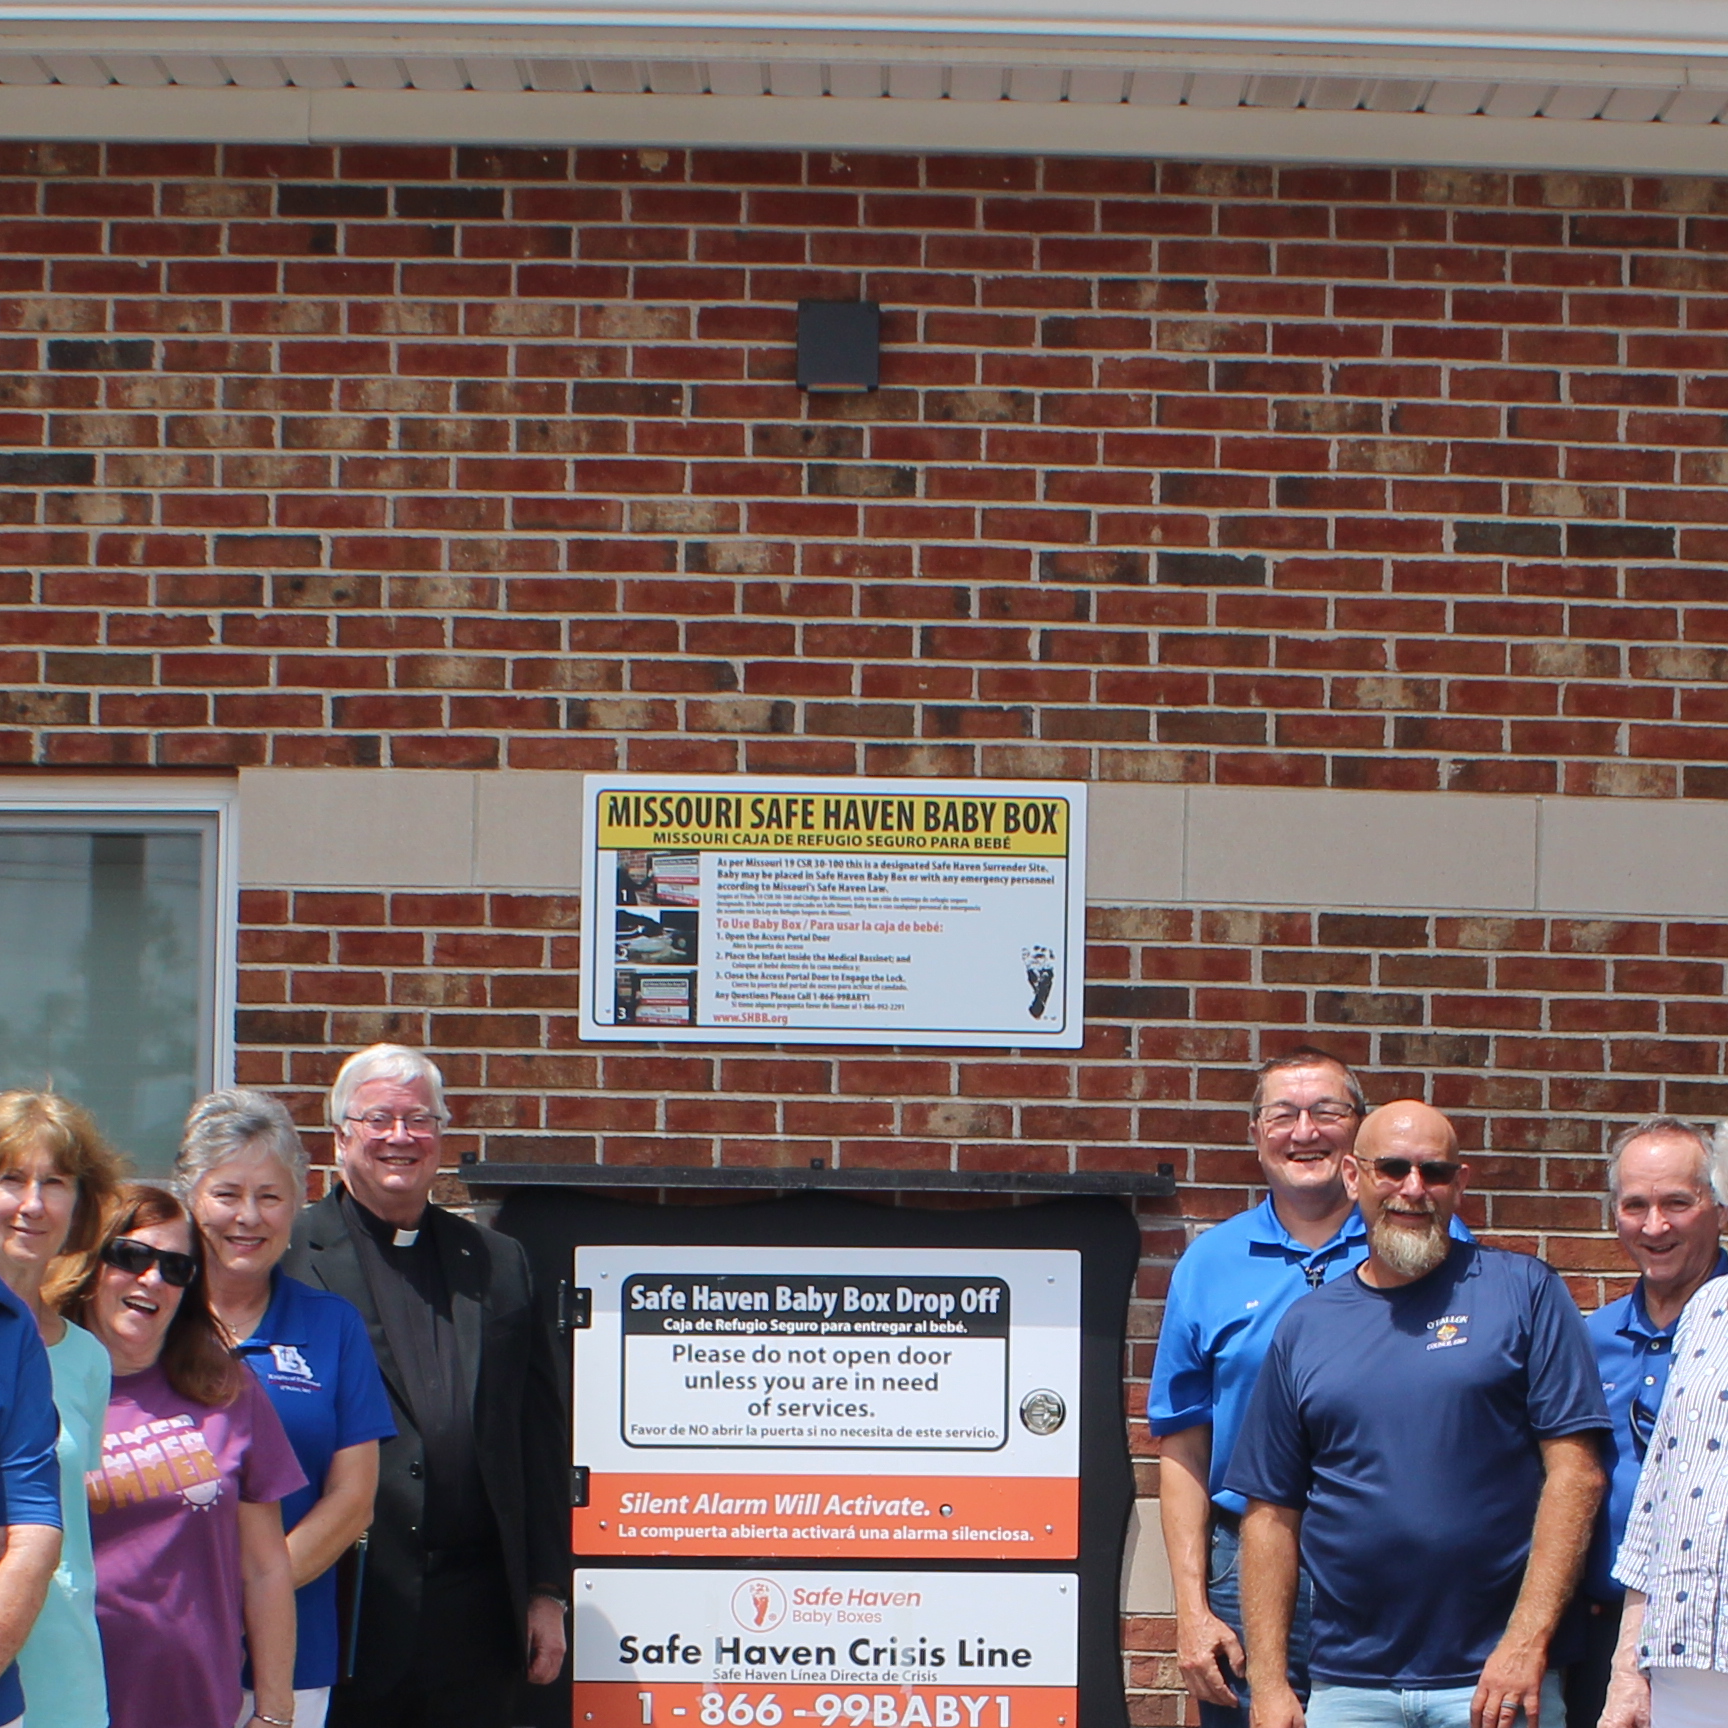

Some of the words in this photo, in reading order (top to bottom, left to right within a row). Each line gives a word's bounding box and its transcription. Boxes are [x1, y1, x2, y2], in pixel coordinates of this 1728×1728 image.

[608, 796, 740, 829] MISSOURI
[751, 798, 813, 830] SAFE
[824, 799, 913, 831] HAVEN
[924, 800, 995, 833] BABY
[1004, 801, 1056, 834] BOX
[652, 831, 728, 844] MISSOURI
[731, 832, 770, 845] CAJA
[773, 833, 793, 845] DE
[796, 833, 862, 846] REFUGIO
[865, 835, 927, 848] SEGURO
[930, 836, 970, 848] PARA
[973, 835, 1011, 849] BEBÉ
[717, 857, 727, 868] As
[728, 860, 744, 870] per
[745, 858, 782, 868] Missouri
[845, 859, 862, 870] this
[864, 859, 871, 870] is
[872, 862, 878, 870] a
[879, 860, 930, 873] designated
[931, 860, 951, 871] Safe
[952, 861, 981, 871] Haven
[982, 861, 1026, 872] Surrender
[1028, 862, 1048, 872] Site.
[717, 869, 739, 882] Baby
[740, 872, 760, 882] may
[761, 870, 773, 880] be
[772, 870, 803, 883] placed
[804, 870, 814, 880] in
[815, 871, 835, 881] Safe
[836, 871, 865, 881] Haven
[866, 871, 889, 884] Baby
[890, 872, 907, 882] Box
[908, 874, 918, 882] or
[919, 872, 940, 882] with
[941, 875, 958, 885] any
[959, 875, 1009, 885] emergency
[1010, 873, 1055, 886] personnel
[621, 889, 628, 902] 1
[716, 882, 759, 894] according
[761, 882, 771, 892] to
[772, 883, 815, 893] Missouri's
[817, 883, 836, 893] Safe
[838, 883, 866, 893] Haven
[867, 884, 888, 894] Law.
[716, 918, 729, 929] To
[731, 919, 750, 930] Use
[752, 919, 779, 932] Baby
[781, 919, 801, 930] Box
[809, 920, 834, 931] Para
[836, 922, 860, 931] usar
[861, 920, 872, 931] la
[873, 923, 895, 934] caja
[897, 920, 911, 931] de
[912, 921, 943, 932] bebé:
[619, 948, 629, 961] 2
[617, 1007, 627, 1020] 3
[712, 1012, 788, 1025] www.SHBB.org
[630, 1284, 686, 1310] Safe
[692, 1285, 769, 1311] Haven
[775, 1285, 838, 1317] Baby
[843, 1286, 890, 1311] Box
[896, 1287, 955, 1318] Drop
[960, 1287, 1000, 1313] Off
[662, 1317, 693, 1333] Caja
[694, 1317, 713, 1331] de
[714, 1317, 768, 1334] Refugio
[769, 1318, 818, 1334] Seguro
[820, 1321, 851, 1335] para
[853, 1320, 912, 1335] entregar
[913, 1319, 927, 1332] al
[929, 1320, 967, 1333] bebé.
[673, 1343, 744, 1363] Please
[752, 1344, 780, 1363] do
[788, 1347, 824, 1364] not
[833, 1350, 889, 1368] open
[897, 1345, 948, 1365] door
[685, 1370, 756, 1389] unless
[763, 1376, 804, 1395] you
[811, 1376, 847, 1390] are
[855, 1372, 874, 1390] in
[882, 1372, 938, 1391] need
[748, 1397, 770, 1416] of
[778, 1398, 873, 1417] services.
[630, 1424, 665, 1435] Favor
[669, 1424, 685, 1435] de
[688, 1424, 708, 1435] NO
[711, 1424, 742, 1435] abrir
[746, 1424, 757, 1436] la
[760, 1426, 803, 1438] puerta
[807, 1425, 817, 1436] si
[820, 1428, 836, 1436] no
[840, 1426, 893, 1437] necesita
[896, 1425, 912, 1437] de
[915, 1427, 942, 1437] este
[945, 1426, 997, 1438] servicio.
[84, 1449, 222, 1515] UMMER
[620, 1492, 688, 1514] Silent
[693, 1493, 766, 1514] Alarm
[775, 1493, 819, 1515] Will
[824, 1494, 929, 1516] Activate.
[619, 1523, 636, 1537] La
[641, 1525, 726, 1541] compuerta
[731, 1524, 787, 1538] abierta
[792, 1525, 854, 1539] activará
[860, 1528, 888, 1539] una
[893, 1525, 947, 1540] alarma
[952, 1526, 1033, 1541] silenciosa.
[791, 1587, 843, 1606] Safe
[846, 1588, 921, 1606] Haven
[793, 1609, 831, 1626] Baby
[837, 1609, 881, 1623] Boxes
[618, 1635, 701, 1665] Safe
[715, 1636, 835, 1665] Haven
[848, 1636, 945, 1667] Crisis
[958, 1637, 1031, 1668] Line
[713, 1667, 741, 1683] Safe
[745, 1668, 786, 1683] Haven
[791, 1668, 826, 1683] Línea
[830, 1669, 878, 1684] Directa
[882, 1669, 898, 1684] de
[902, 1670, 937, 1682] Crisis
[639, 1692, 651, 1723] 1
[700, 1692, 782, 1726] 866
